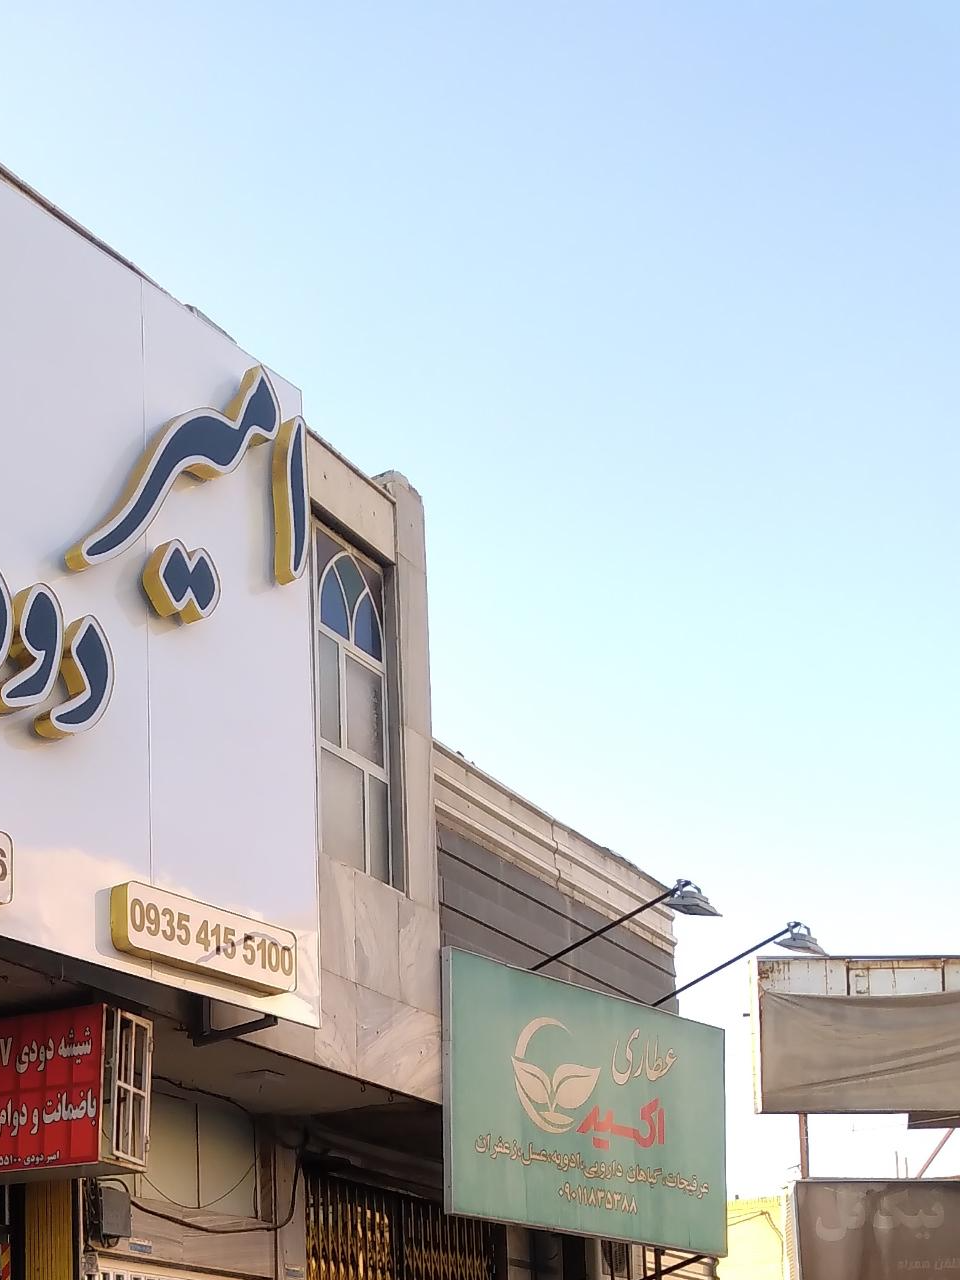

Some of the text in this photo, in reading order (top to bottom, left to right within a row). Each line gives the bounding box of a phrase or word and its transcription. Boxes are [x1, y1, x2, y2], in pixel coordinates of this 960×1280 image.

[66, 365, 309, 624] امیر
[130, 898, 294, 977] 0935 415 5100
[16, 1038, 55, 1074] دودی
[58, 1026, 93, 1064] شیشه
[611, 1027, 678, 1086] عطاری
[30, 1107, 39, 1135] و
